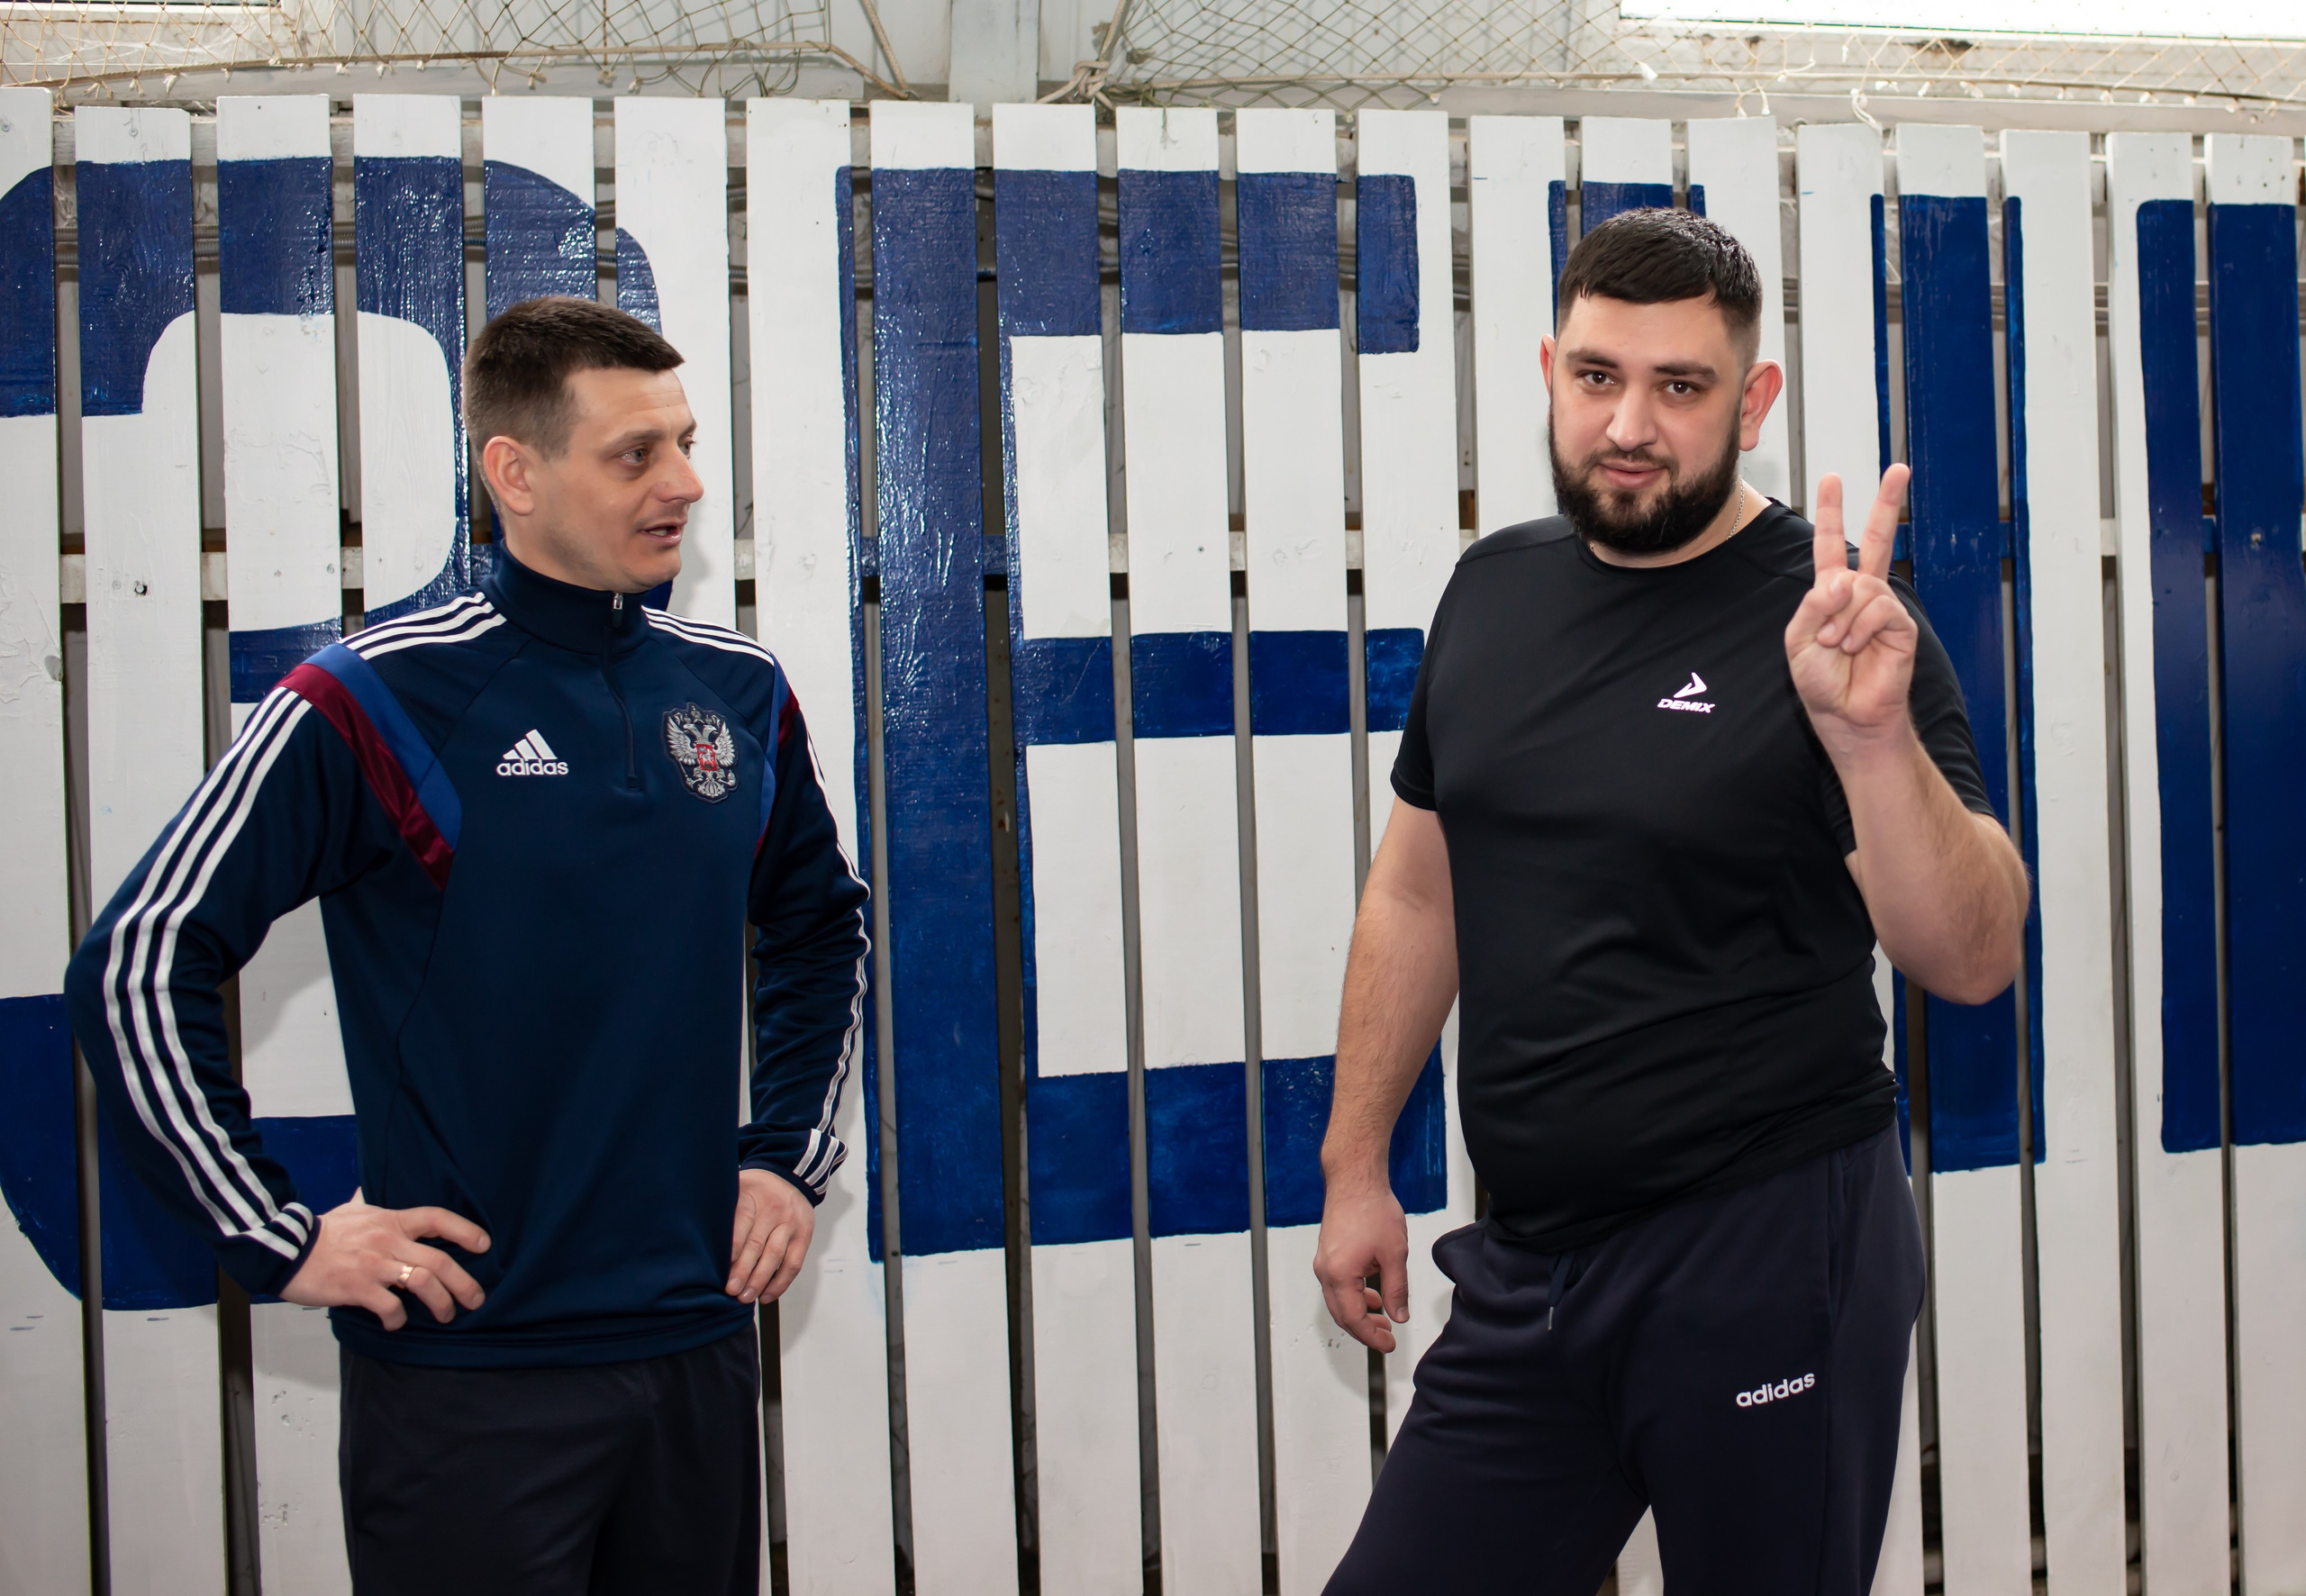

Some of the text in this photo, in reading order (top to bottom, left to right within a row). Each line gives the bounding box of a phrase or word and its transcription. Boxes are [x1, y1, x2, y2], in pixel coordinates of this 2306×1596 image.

[1657, 698, 1716, 714] DEMIX
[495, 757, 569, 776] adidas
[1736, 1373, 1816, 1408] adidas
